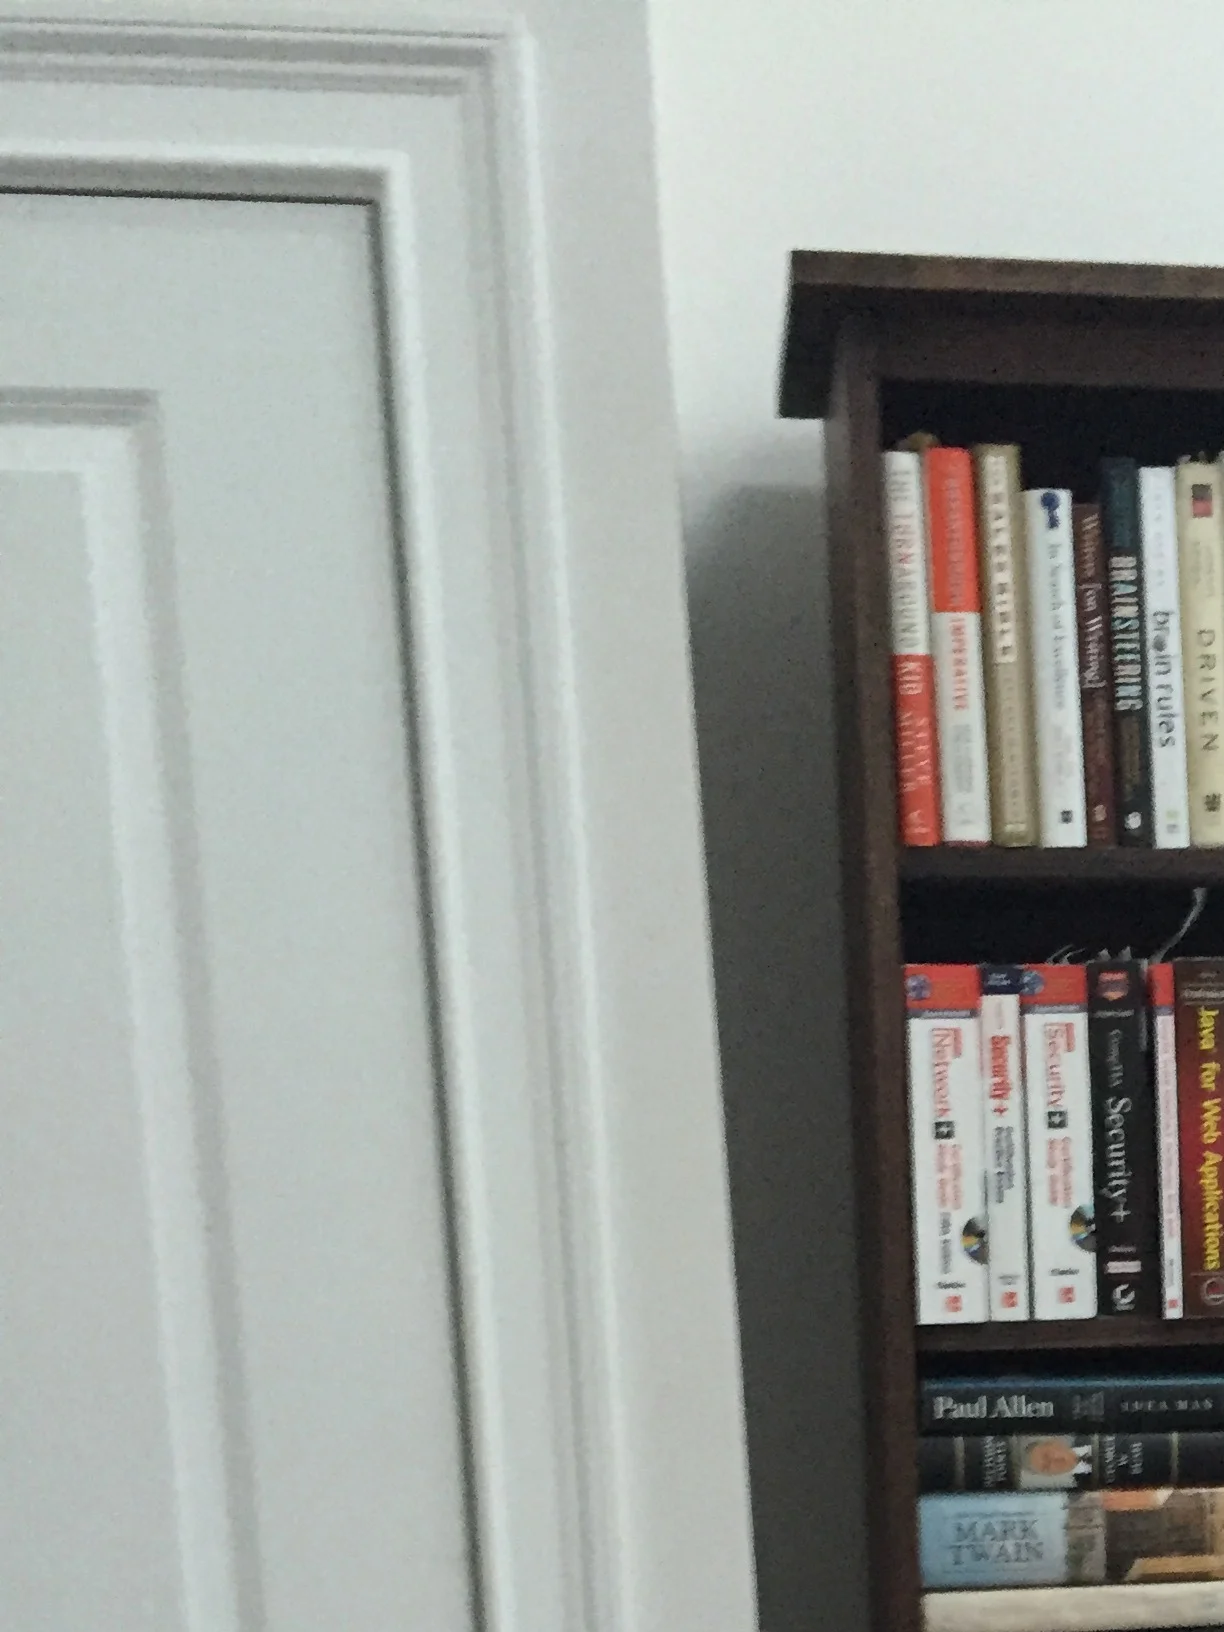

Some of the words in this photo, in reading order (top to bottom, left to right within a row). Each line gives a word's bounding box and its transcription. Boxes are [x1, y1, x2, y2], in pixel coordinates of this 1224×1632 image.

[1108, 556, 1142, 711] BRAINSTEERING
[900, 660, 922, 695] KID
[1197, 628, 1219, 753] DRIVEN
[1156, 684, 1179, 748] rules
[931, 1029, 951, 1118] Network
[991, 1035, 1012, 1100] Security
[1046, 1028, 1066, 1107] Security
[1201, 1062, 1219, 1090] for
[1201, 1098, 1221, 1144] Web
[1099, 1096, 1132, 1223] Security+
[1198, 1151, 1224, 1271] Applications
[933, 1395, 988, 1420] Paul
[991, 1394, 1054, 1418] Allen
[949, 1544, 1045, 1565] TWAIN
[955, 1520, 1039, 1542] MARK
